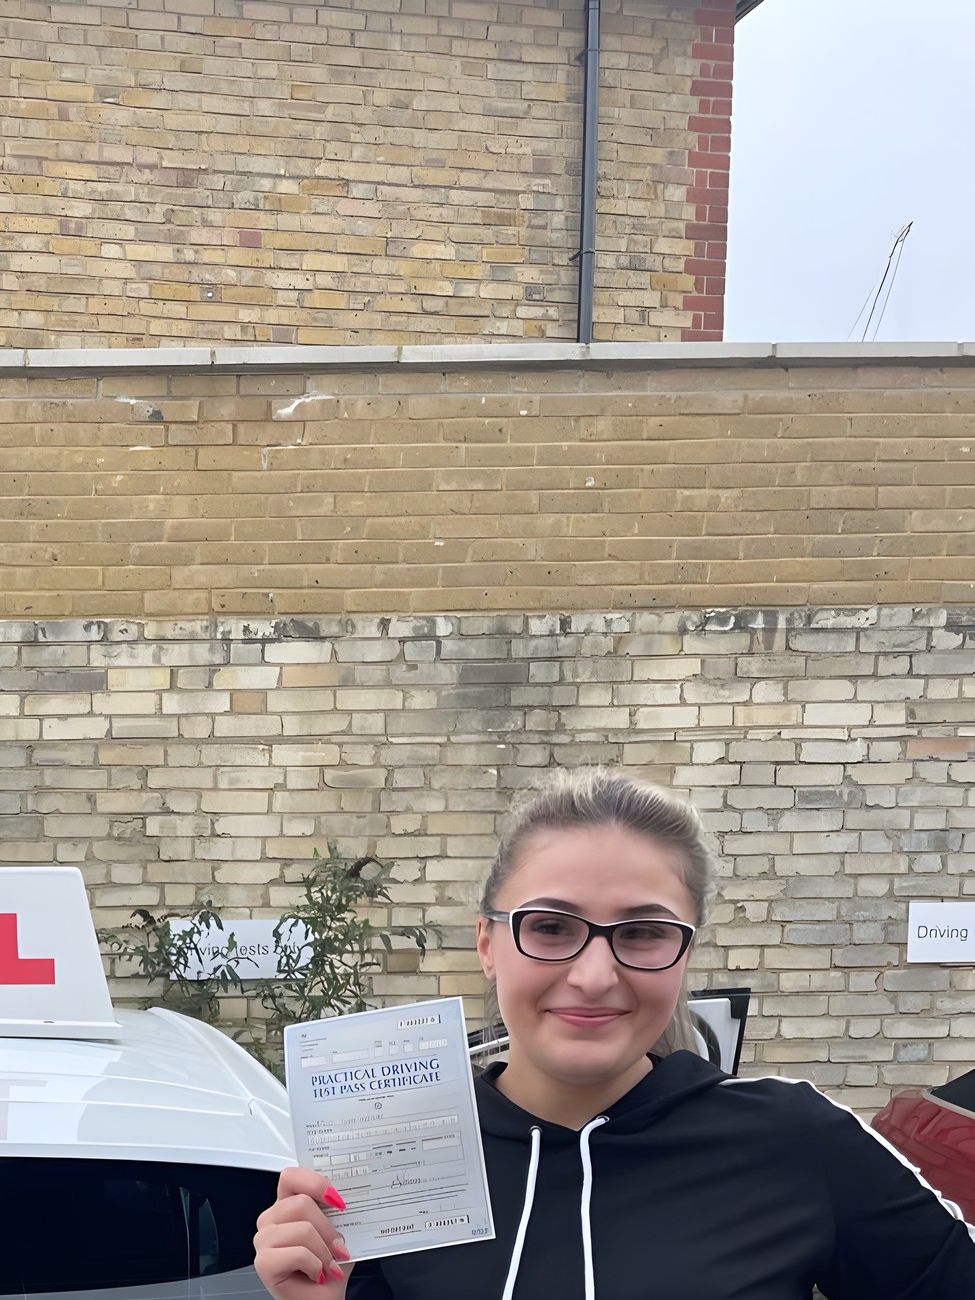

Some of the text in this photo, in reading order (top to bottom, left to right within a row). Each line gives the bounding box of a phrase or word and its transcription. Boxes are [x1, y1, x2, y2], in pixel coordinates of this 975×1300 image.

[917, 924, 969, 942] Driving
[311, 1058, 440, 1086] PRACTICAL DRIVING
[340, 1082, 366, 1095] PASS
[369, 1071, 441, 1091] CERTIFICATE
